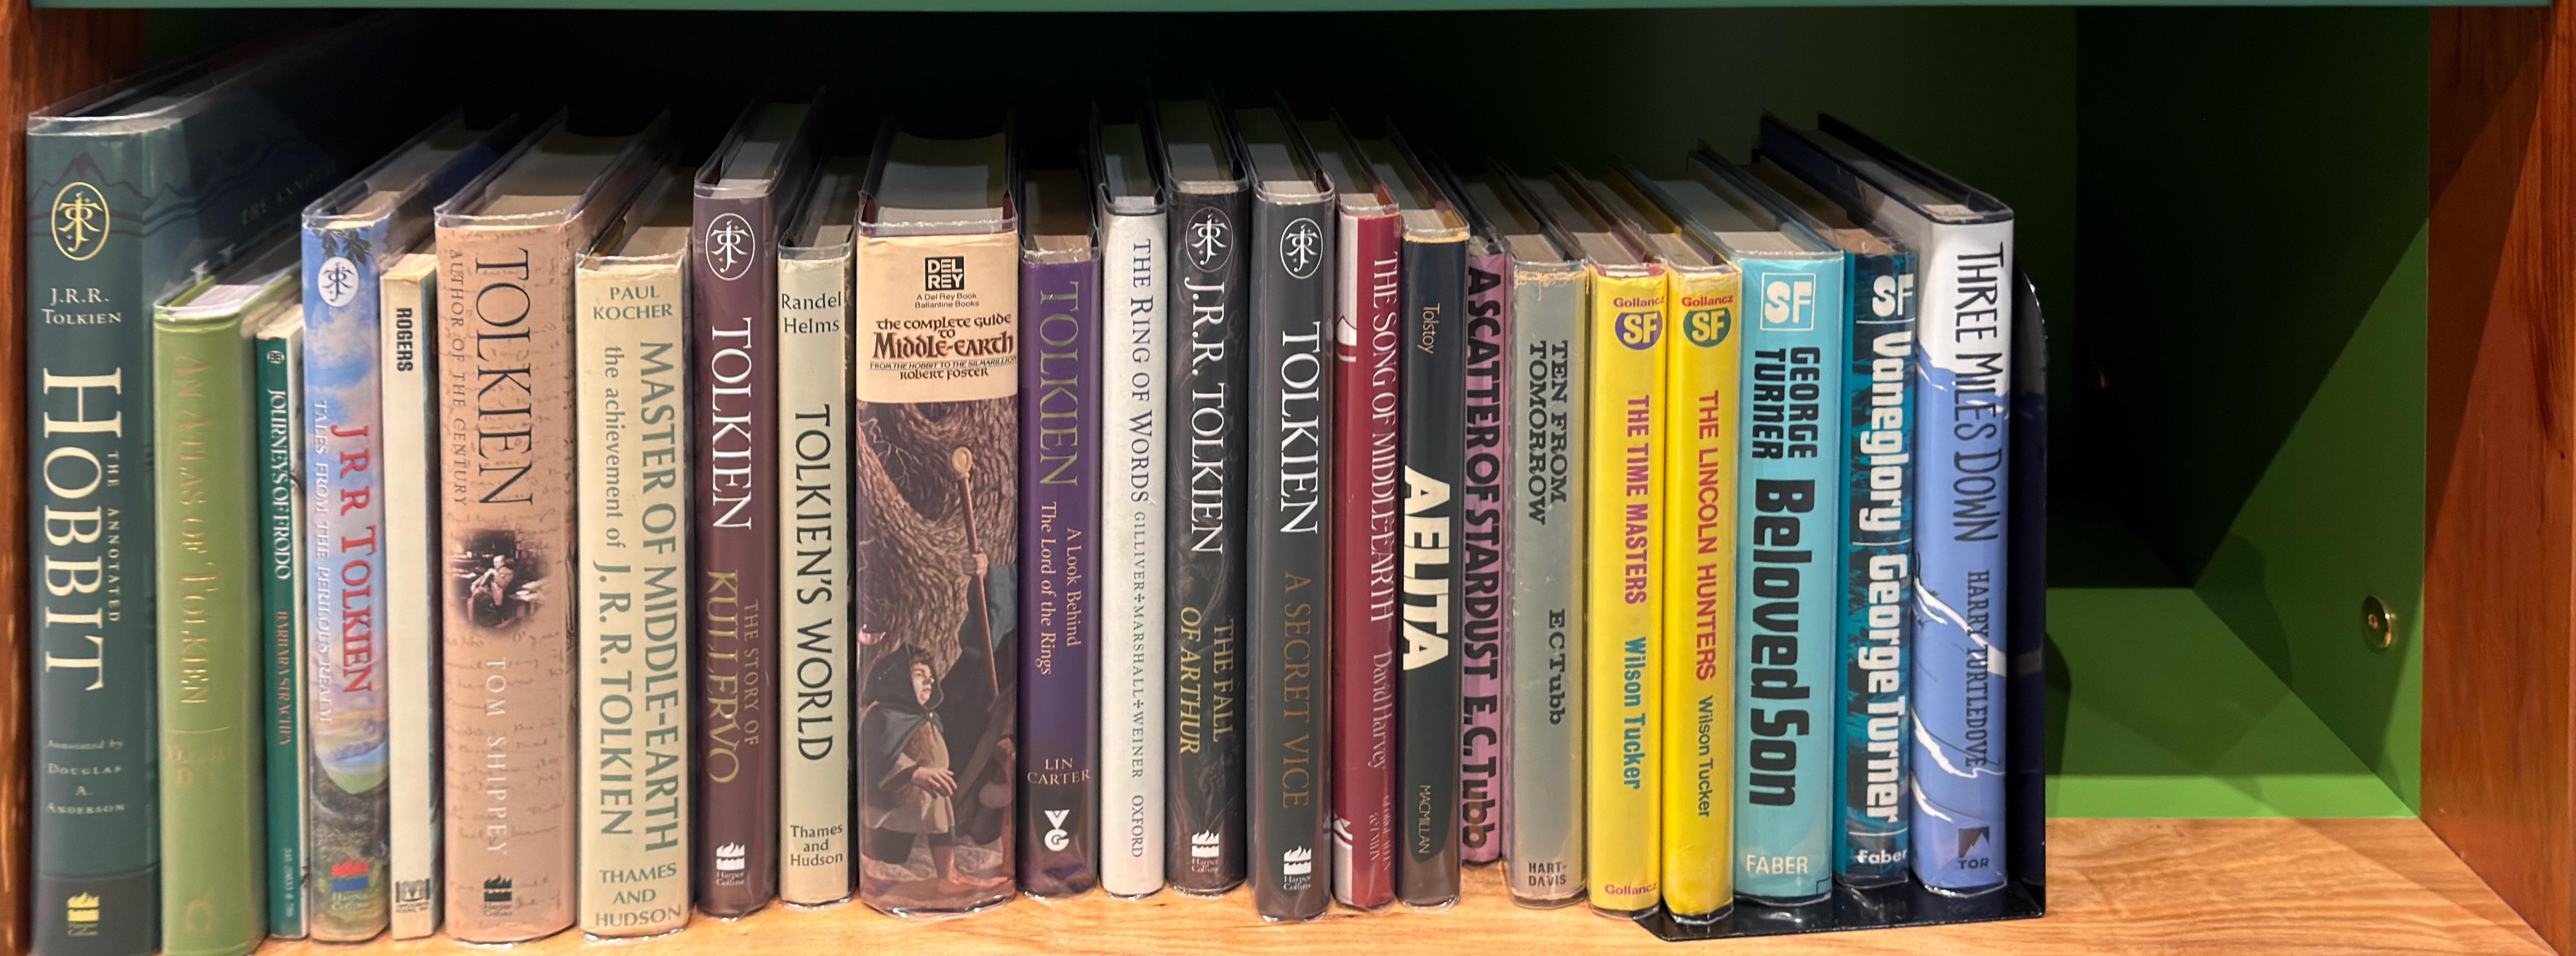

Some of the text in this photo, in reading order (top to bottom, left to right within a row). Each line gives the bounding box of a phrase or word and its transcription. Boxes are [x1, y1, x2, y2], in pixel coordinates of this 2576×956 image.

[51, 288, 110, 304] J.R.R.
[593, 302, 673, 320] KOCHER
[610, 285, 660, 300] PAUL
[781, 291, 841, 310] Randel
[927, 258, 963, 274] DEL
[927, 274, 963, 289] REY
[940, 293, 955, 301] Rey
[1613, 296, 1665, 308] Gollancz
[1681, 295, 1734, 307] Gollancz
[1765, 281, 1813, 324] SF
[1872, 273, 1914, 317] SF
[396, 308, 413, 372] ROGERS
[449, 250, 468, 506] AUTHOR OF THE CENTURY
[475, 247, 532, 506] TOLKIEN
[784, 317, 840, 333] Helms
[870, 362, 891, 370] FROM
[968, 356, 1017, 367] SILMARILLION
[1417, 303, 1440, 355] Tolstoy
[1623, 312, 1658, 345] SF
[1692, 310, 1725, 342] SF
[712, 317, 752, 530] TOLKIEN
[1039, 281, 1079, 486] TOLKIEN
[1184, 276, 1225, 555] J.R.R. TOLKIEN
[1280, 321, 1321, 534] TOLKIEN
[1370, 250, 1398, 623] THE SONG OF MIDDLE-EARTH
[1527, 340, 1548, 526] TOMORROW
[1549, 340, 1568, 503] TEN FROM
[1752, 348, 1786, 459] TURNER
[1788, 347, 1821, 459] GEORGE
[1859, 331, 1912, 532] Vaneglory
[1953, 241, 2004, 543] THREE MILES DOWN
[267, 388, 292, 580] JOURNEYS OF FRODO
[605, 346, 627, 548] the achievement of
[1464, 265, 1501, 680] A SCATTER OF STARDUST
[43, 367, 122, 691] HOBBIT
[107, 451, 120, 622] THE ANNOTATED
[314, 400, 333, 722] TALES FROM THE PERILOUS REALM
[331, 425, 378, 692] J R R TOLKIEN
[795, 403, 834, 761] TOLKIEN'S WORLD
[1129, 239, 1154, 858] THE RING OF WORDS GILLIVER MARSHALL WEINER OXFORD
[1403, 465, 1450, 671] AELITA
[179, 562, 221, 703] TOLKIEN
[277, 611, 289, 675] BARBARA
[640, 342, 679, 852] MASTER OF MIDDLE-EARTH
[1035, 501, 1057, 675] The Lord of the Rings
[1066, 528, 1082, 647] A Look Behind
[1623, 394, 1650, 790] THE TIME MASTERS Wilson Tucker
[1695, 390, 1720, 818] THE LINCOLN HUNTERS Wilson Tucker
[1749, 479, 1815, 807] Beloved Son
[593, 560, 633, 835] J. R. R. TOLKIEN
[707, 569, 741, 783] KULLERVO
[744, 599, 759, 745] THE STORY OF
[1180, 607, 1202, 755] OF ARTHUR
[1213, 618, 1234, 743] THE FALL
[1282, 571, 1312, 809] A SECRET VICE
[1373, 650, 1393, 703] David
[1858, 553, 1909, 823] George Turner
[1964, 570, 1990, 768] HARRY TURTLEDOVE
[485, 657, 507, 855] TOM SHIPPEY
[1027, 768, 1090, 785] CARTER
[1045, 758, 1073, 770] LIN
[1368, 702, 1393, 770] Harvey
[599, 862, 677, 884] THAMES
[790, 824, 843, 838] Thames
[790, 853, 843, 867] Hudson
[803, 839, 829, 852] and
[1419, 785, 1431, 854] MACMILLAN
[1528, 862, 1567, 875] HART-
[1746, 854, 1809, 875] FABER
[1857, 848, 1908, 864] Faber
[1957, 857, 1990, 870] TOR
[595, 905, 682, 927] HUDSON
[613, 888, 656, 904] AND
[1528, 874, 1567, 887] DAVIS
[1604, 882, 1657, 896] Gollancz
